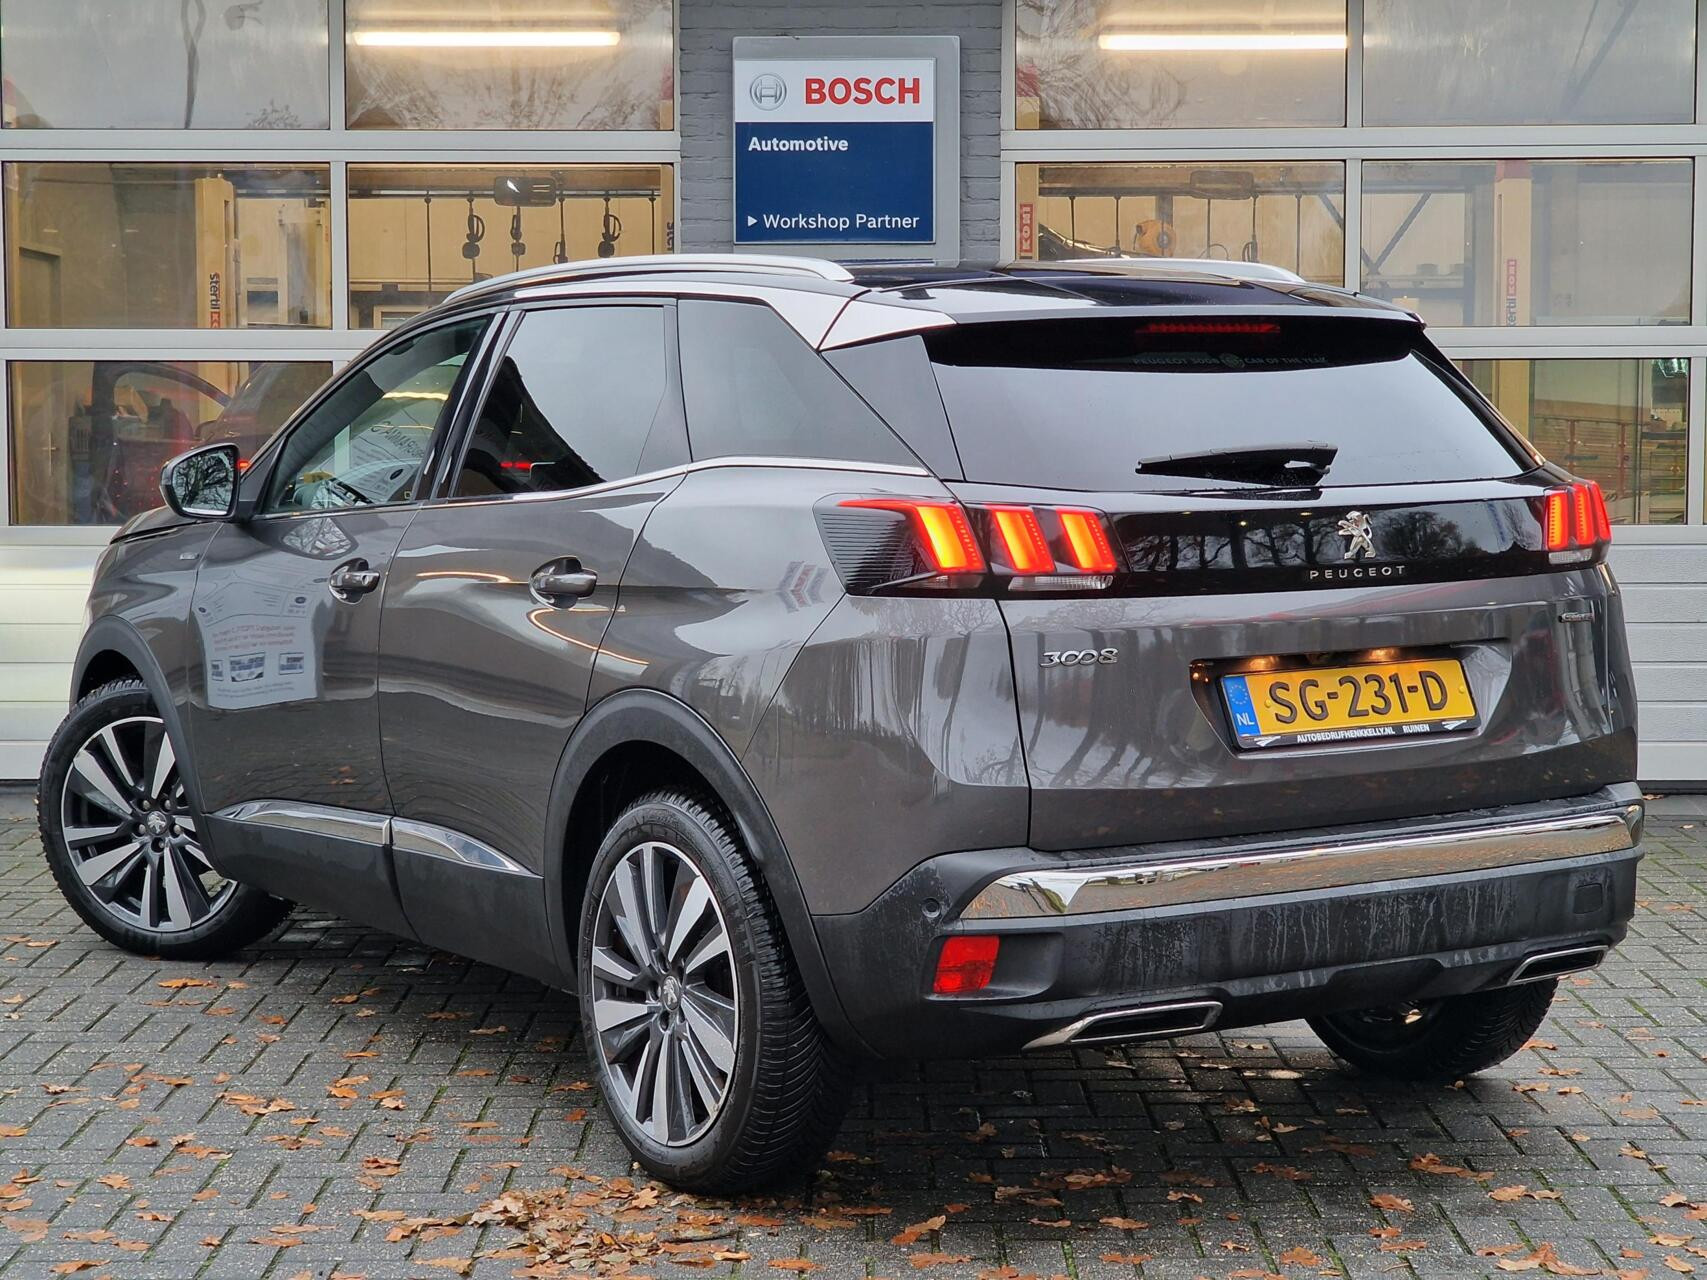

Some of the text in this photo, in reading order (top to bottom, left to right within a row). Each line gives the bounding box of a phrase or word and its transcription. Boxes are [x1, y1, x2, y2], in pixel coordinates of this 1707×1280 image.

[805, 77, 920, 105] BOSCH
[748, 136, 849, 151] Automotive
[763, 213, 920, 231] Workshop Partner
[209, 272, 221, 310] stertil
[1309, 565, 1406, 580] PEUGEOT
[1040, 648, 1118, 668] 3008
[1268, 670, 1448, 724] SG-231-D
[1236, 712, 1255, 727] NL
[1297, 723, 1430, 744] AUTOBEDRIJFHENKKELLY.NL RUINEN
